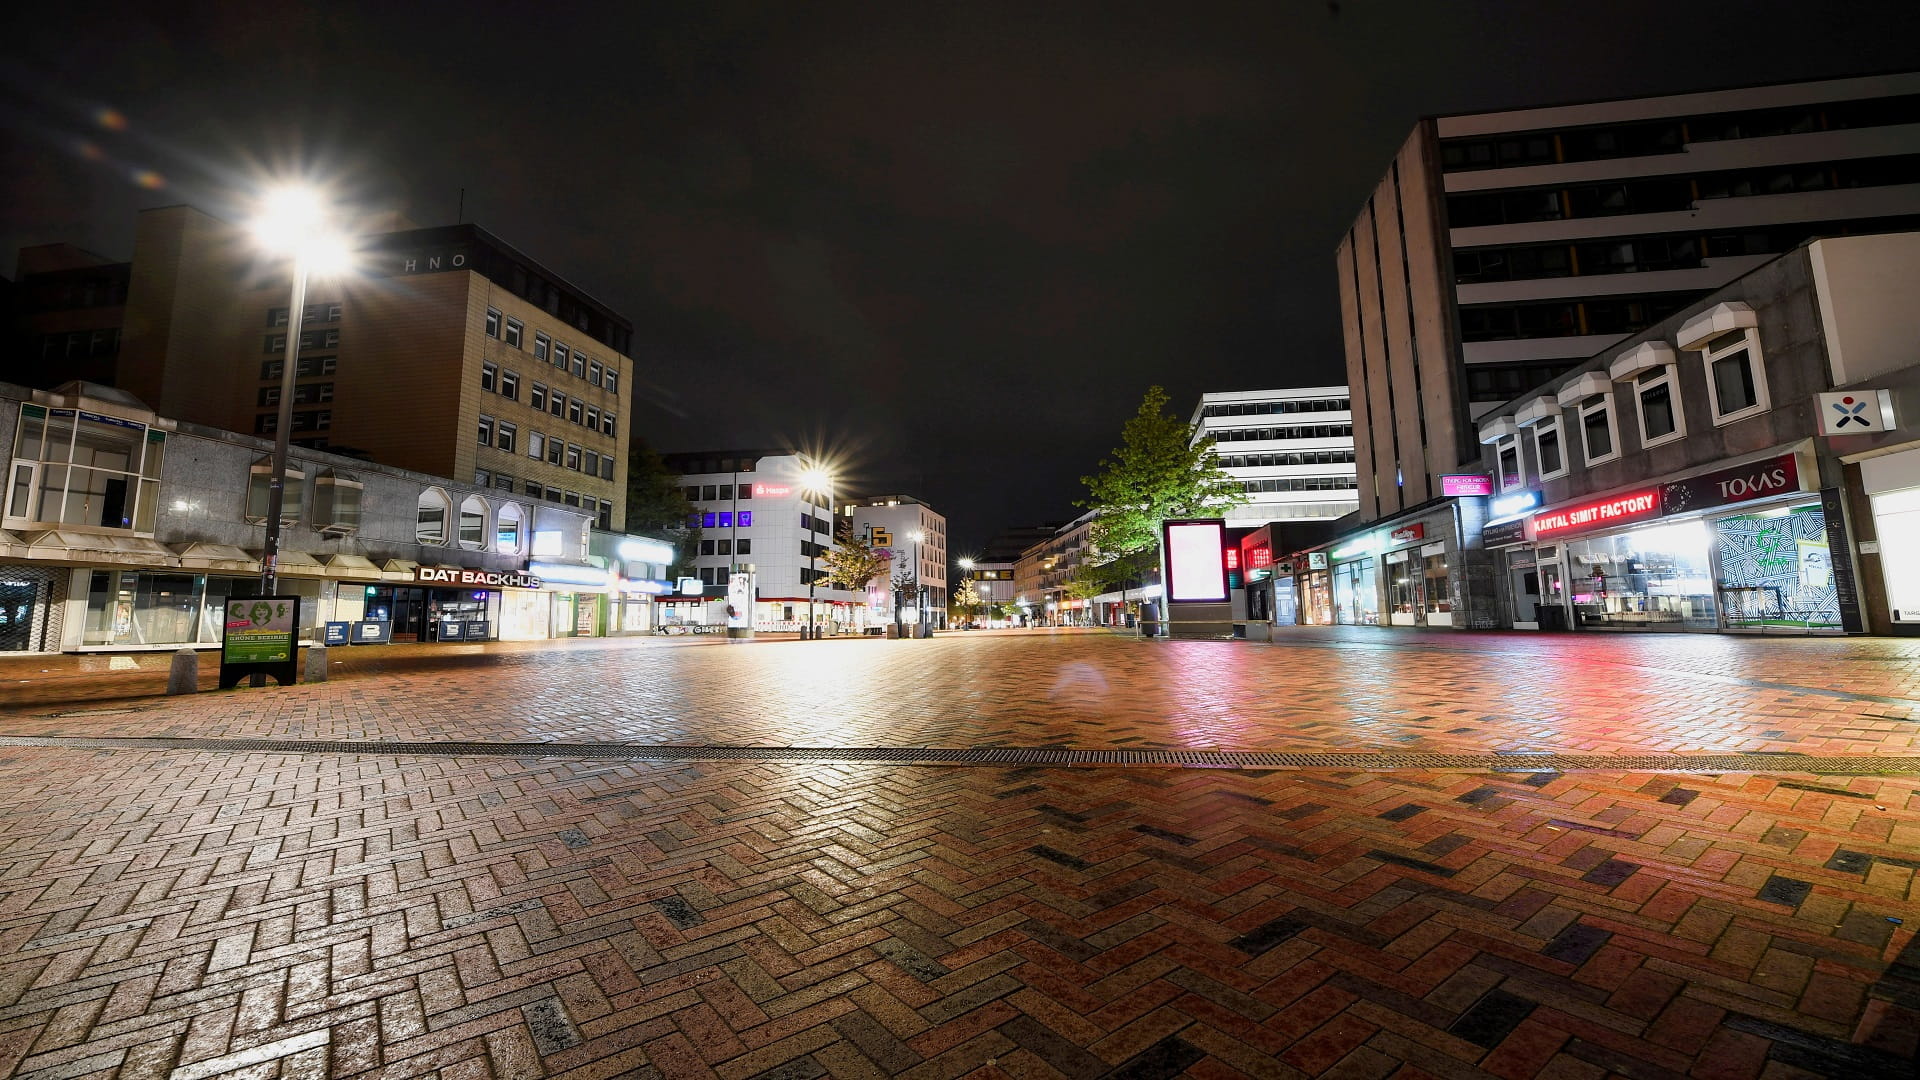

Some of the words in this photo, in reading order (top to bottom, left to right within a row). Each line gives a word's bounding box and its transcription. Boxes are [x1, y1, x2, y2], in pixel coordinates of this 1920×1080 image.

[1534, 515, 1568, 532] KARTAL
[1570, 507, 1598, 525] SIMIT
[1600, 494, 1653, 518] FACTORY
[420, 568, 459, 582] DAT
[462, 571, 540, 588] BACKHUS
